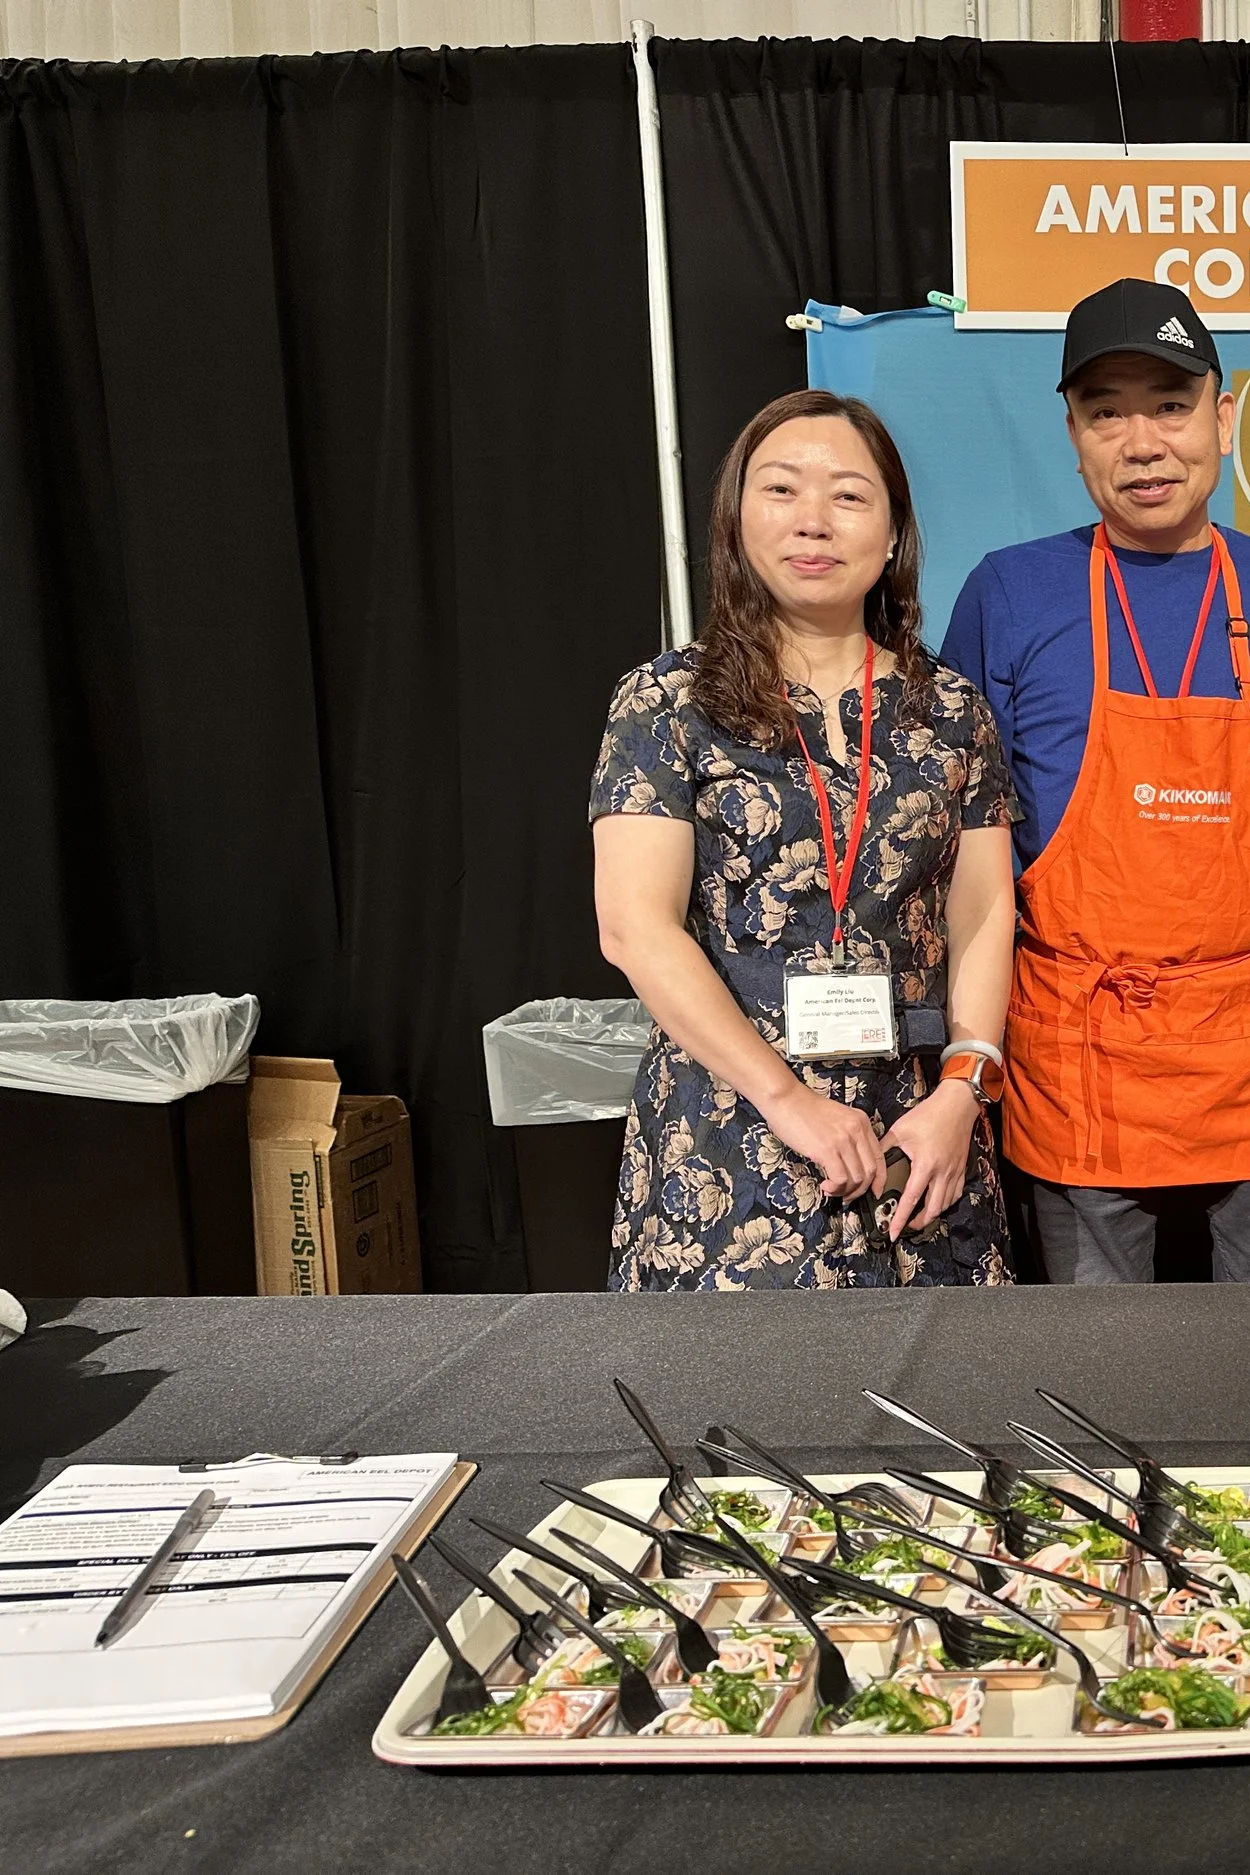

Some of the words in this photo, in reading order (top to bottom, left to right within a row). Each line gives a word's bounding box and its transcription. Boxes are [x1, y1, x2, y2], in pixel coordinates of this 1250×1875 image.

[1156, 331, 1195, 349] adidas
[1139, 810, 1155, 820] Over
[1172, 815, 1190, 823] years
